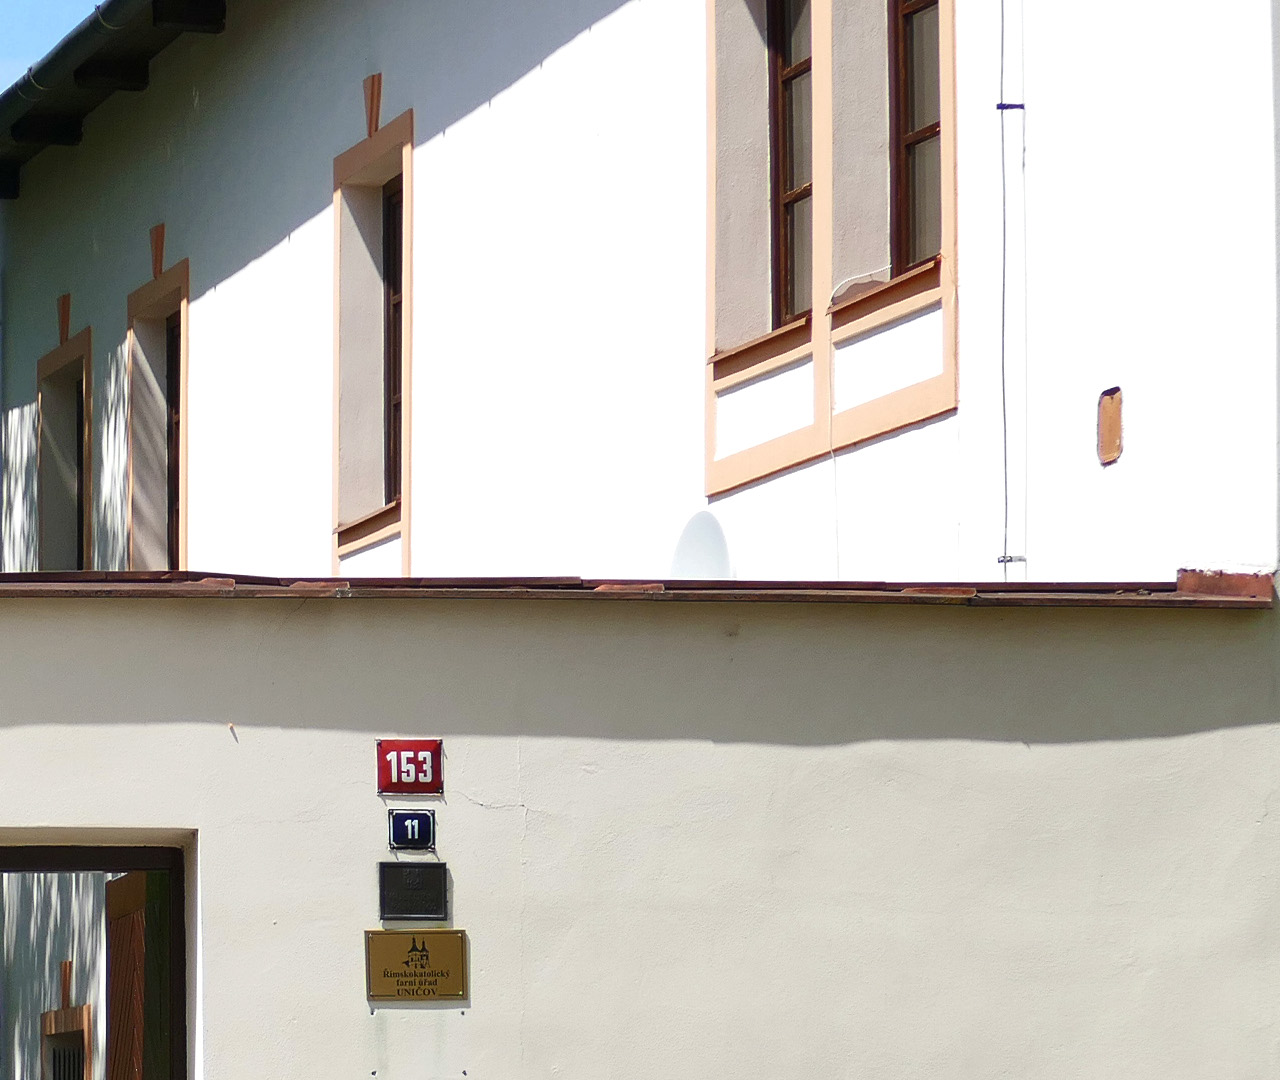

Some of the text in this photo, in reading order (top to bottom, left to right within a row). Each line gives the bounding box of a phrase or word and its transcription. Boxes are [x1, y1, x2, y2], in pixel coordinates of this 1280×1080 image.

[386, 751, 432, 783] 153
[405, 819, 419, 839] 11
[383, 968, 450, 979] Římskokatolický
[397, 987, 438, 996] UNIČOV
